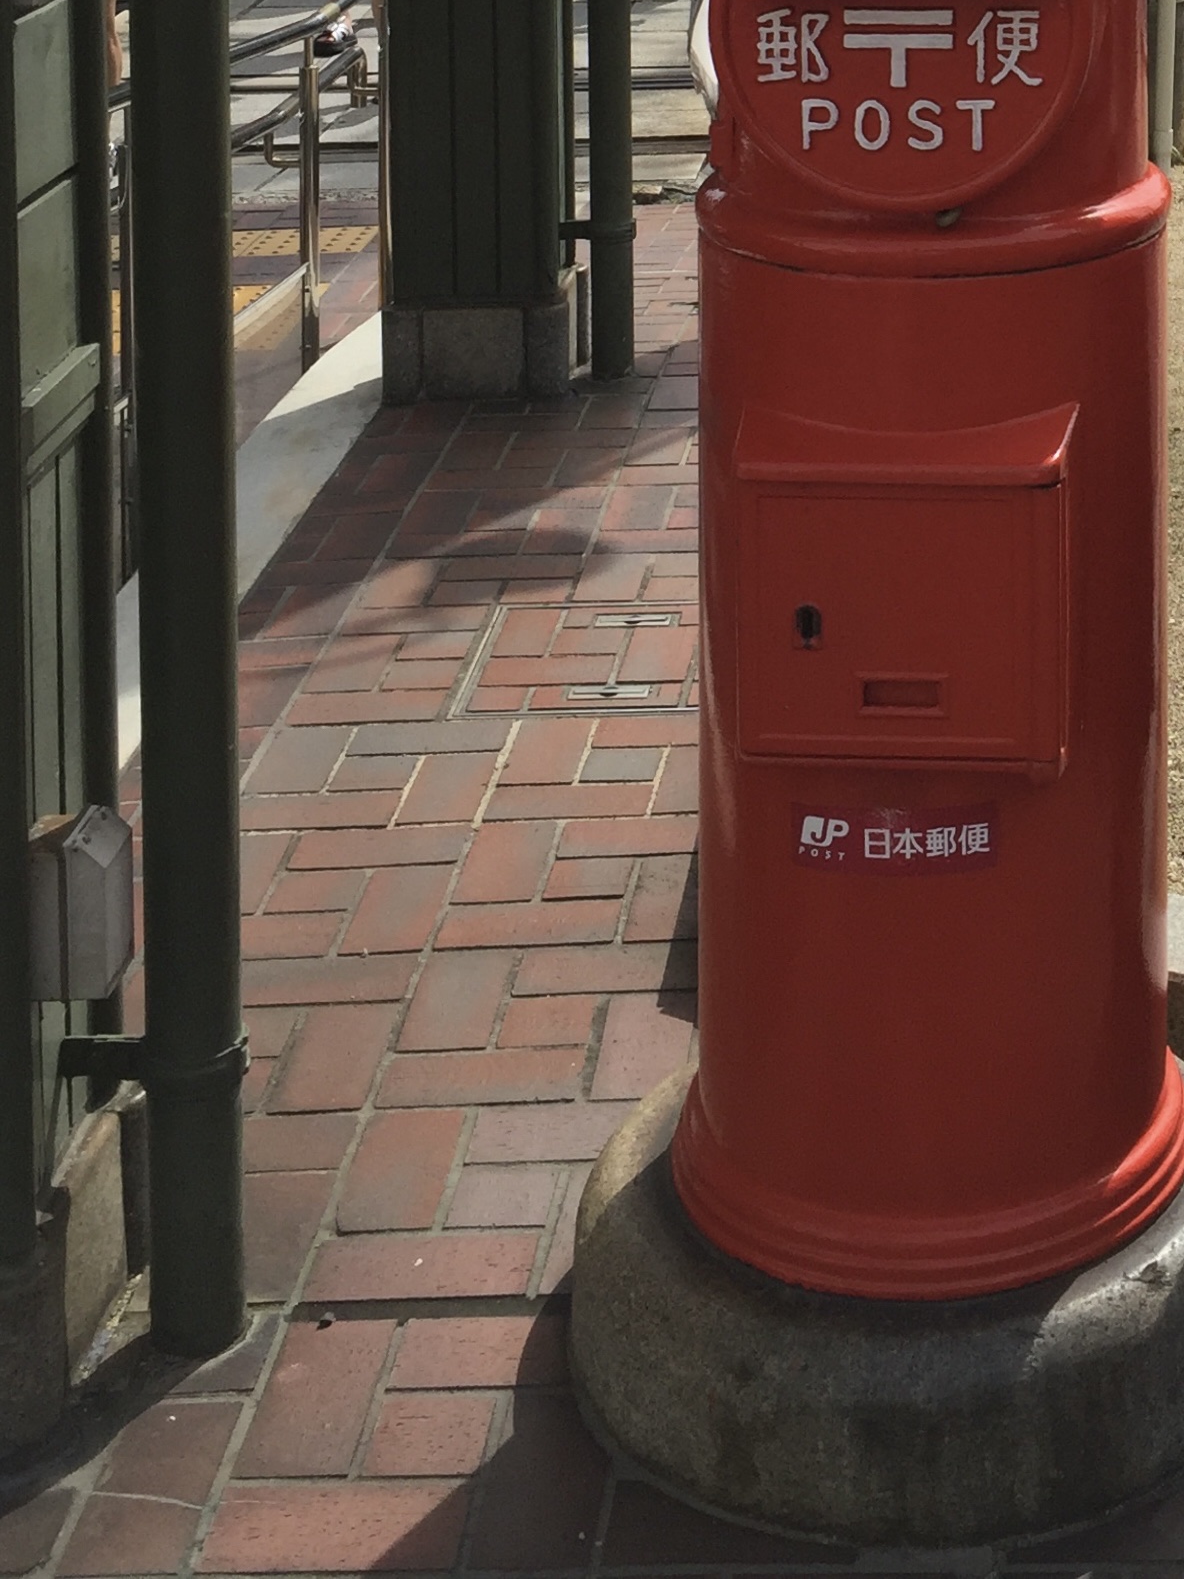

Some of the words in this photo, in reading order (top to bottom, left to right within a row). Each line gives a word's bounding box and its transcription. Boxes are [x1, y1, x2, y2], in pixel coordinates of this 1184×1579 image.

[801, 98, 996, 152] POST
[800, 815, 850, 847] JP
[863, 822, 991, 859] 日本郵便
[798, 846, 846, 861] POST
